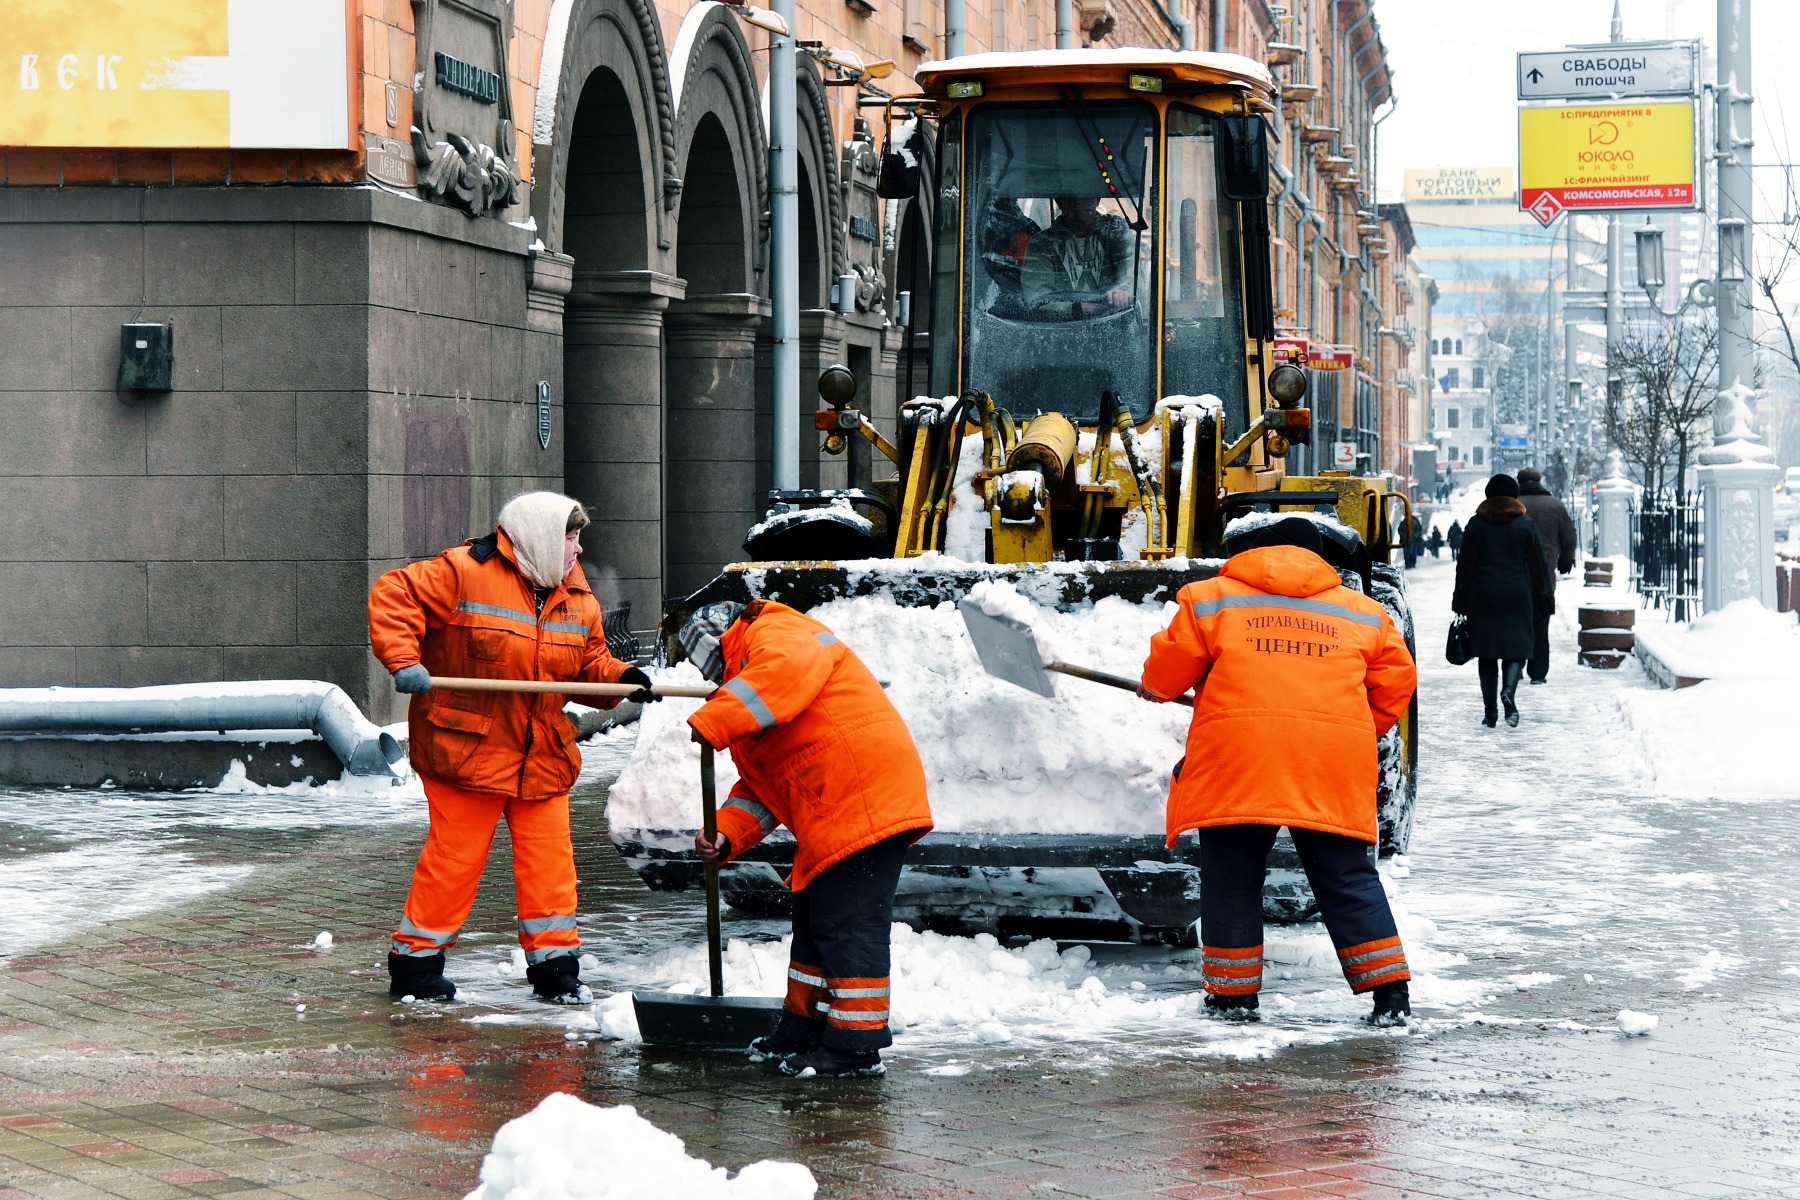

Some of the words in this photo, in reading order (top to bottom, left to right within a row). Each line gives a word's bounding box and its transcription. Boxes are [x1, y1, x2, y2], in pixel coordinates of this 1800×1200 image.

[1562, 57, 1646, 72] СВАБОДЫ
[1575, 75, 1635, 86] плошча
[389, 89, 396, 118] 8
[1440, 169, 1477, 178] БАНК
[1416, 177, 1501, 188] ТОРГОВЫЙ
[1563, 189, 1664, 200] КОМСОМОЛЬСКАЯ,
[1309, 359, 1346, 369] АПТЕКА
[1246, 615, 1339, 639] УПРАВЛЕНИЕ
